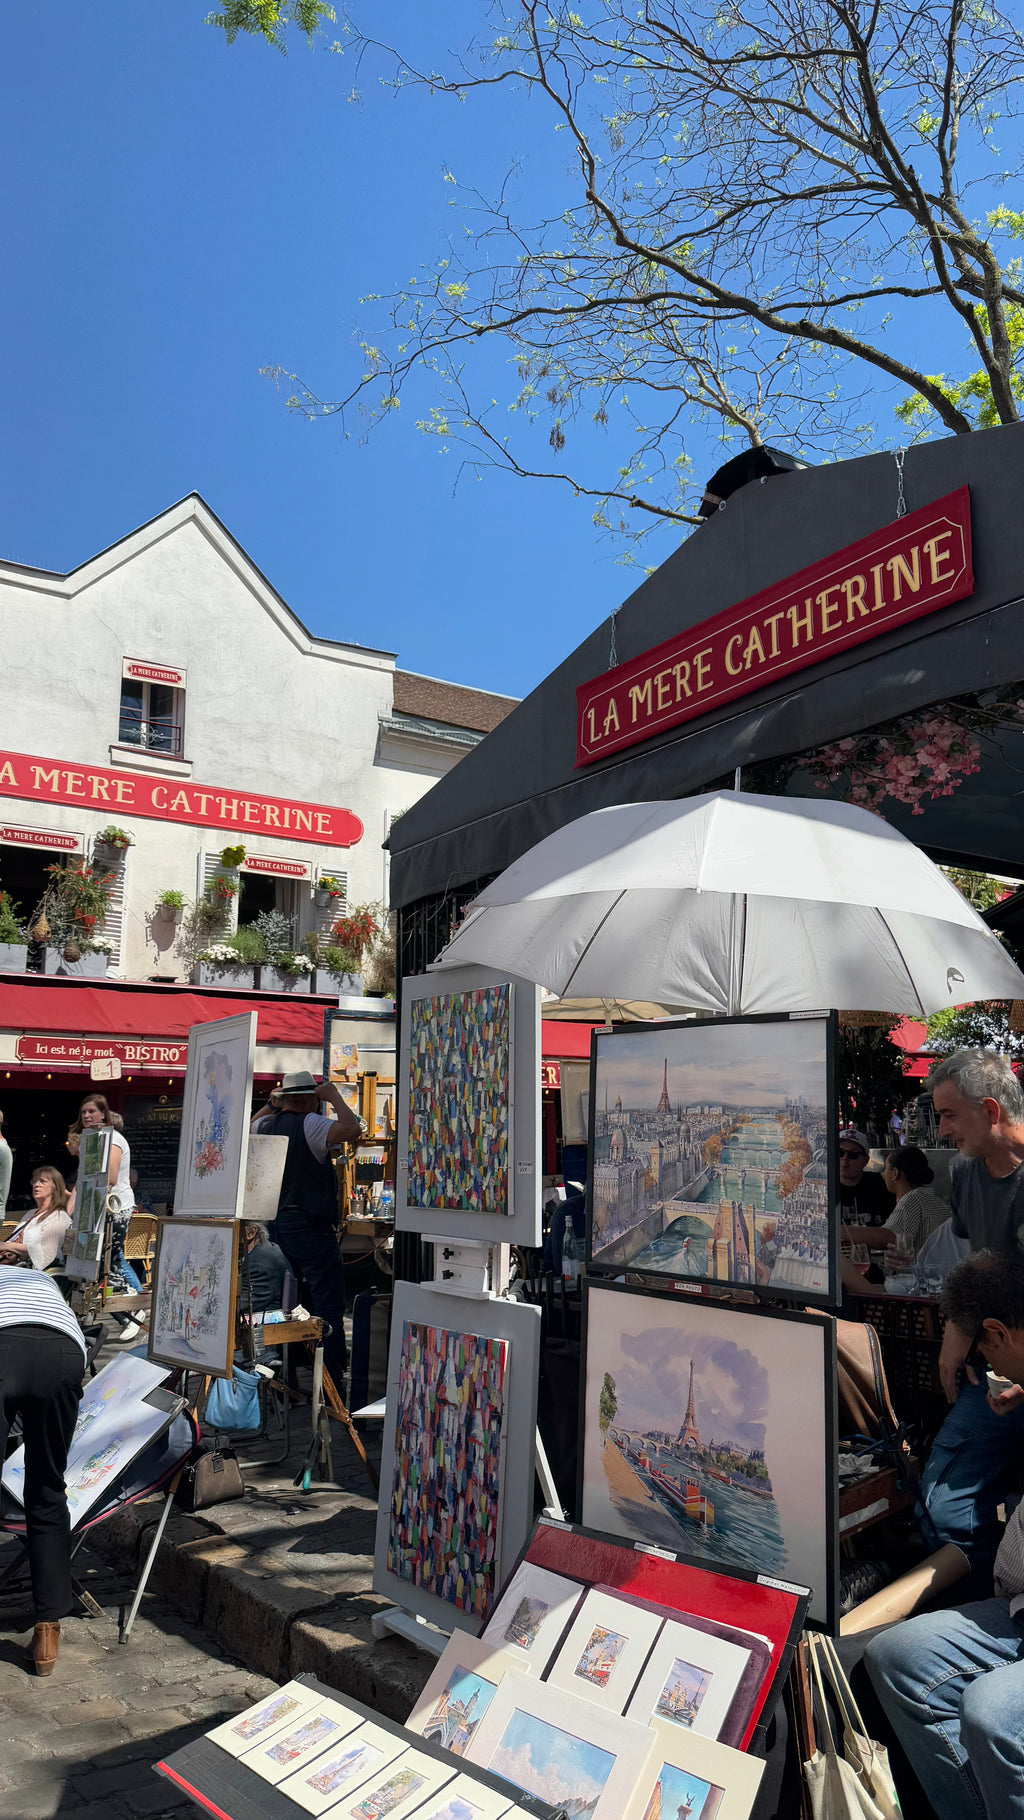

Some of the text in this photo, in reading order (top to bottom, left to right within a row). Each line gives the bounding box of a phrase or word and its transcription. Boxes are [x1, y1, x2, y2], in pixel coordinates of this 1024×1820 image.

[588, 530, 955, 744] LA MERE CATHERINE
[138, 668, 151, 676] MERE
[151, 671, 178, 681] CATHERINE
[30, 765, 136, 804] MERE
[151, 786, 333, 835] CATHERINE
[14, 832, 33, 840] MERE
[34, 835, 74, 847] CATHERINE
[256, 861, 272, 869] MERE
[272, 863, 304, 873] CATHERINE
[35, 1043, 48, 1054] Ici
[50, 1045, 66, 1054] est
[68, 1045, 81, 1055] né
[82, 1046, 92, 1056] le
[94, 1047, 114, 1057] mot
